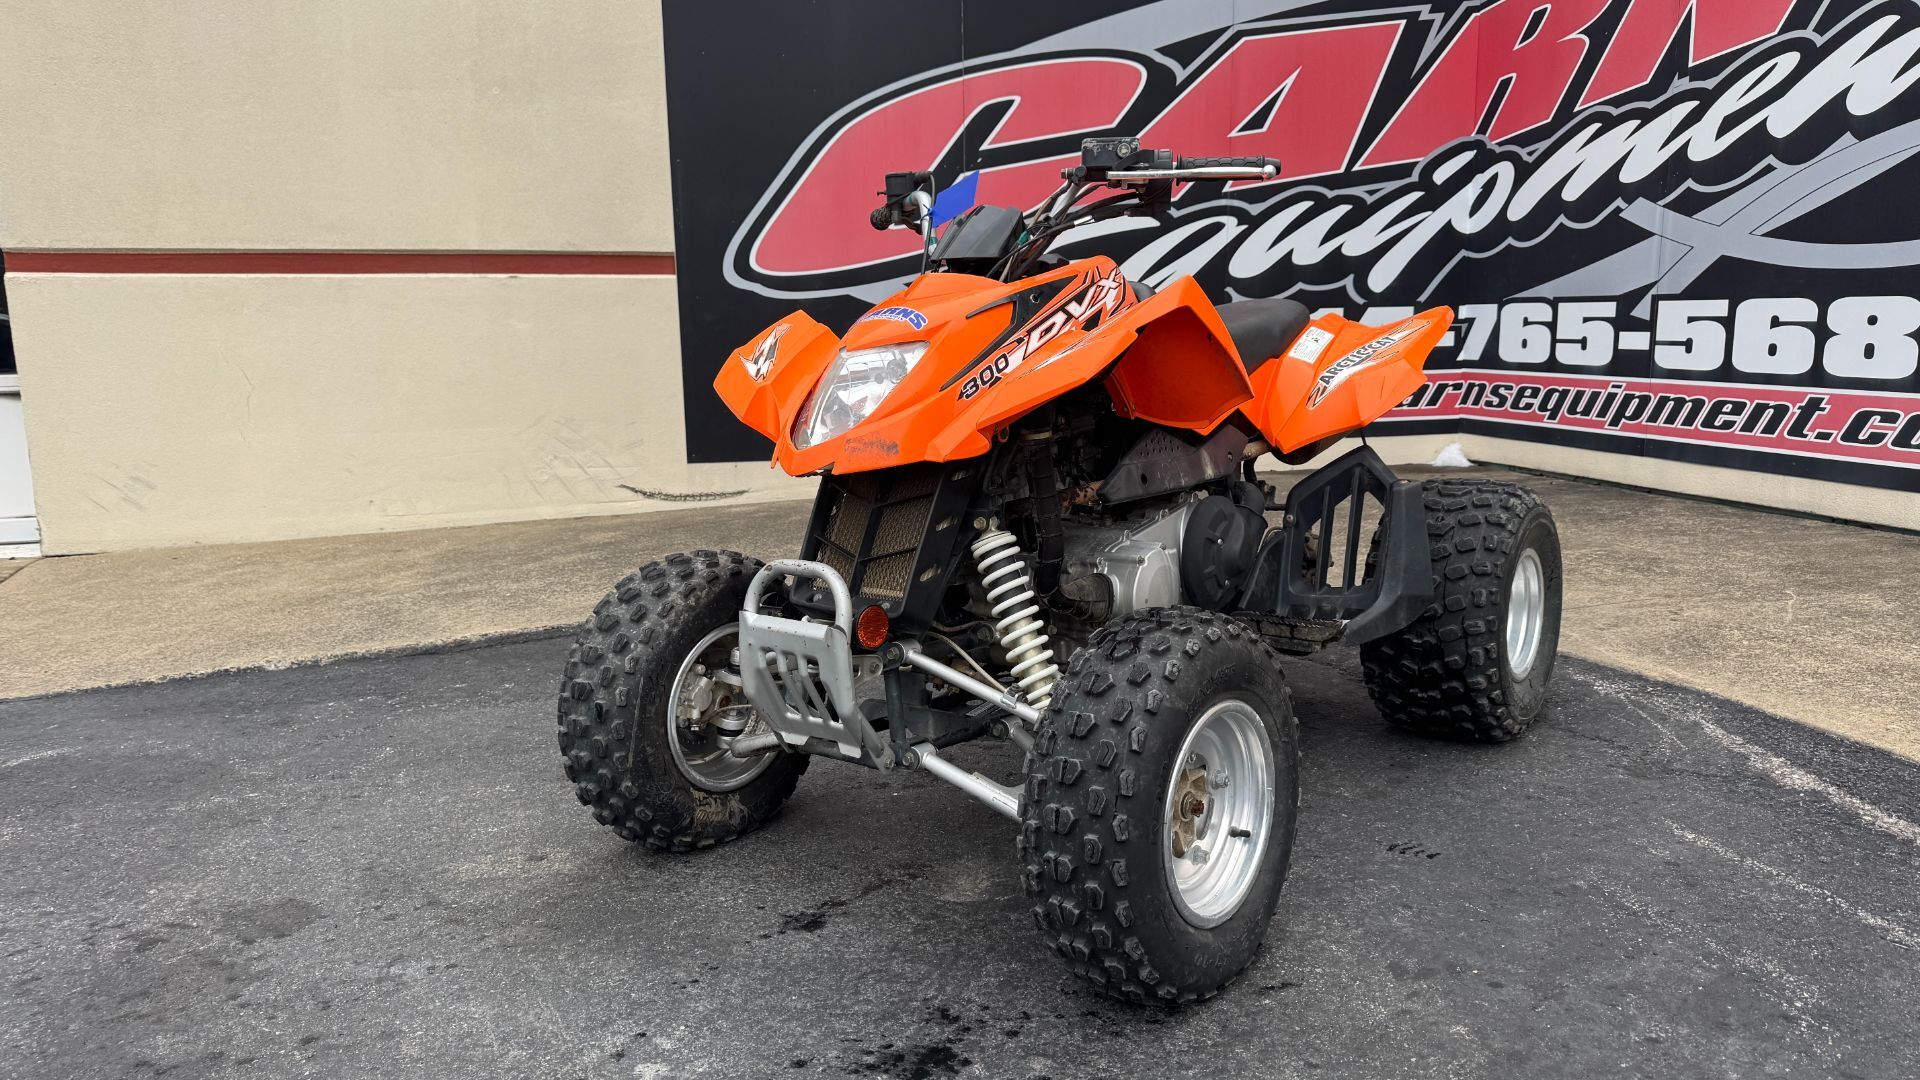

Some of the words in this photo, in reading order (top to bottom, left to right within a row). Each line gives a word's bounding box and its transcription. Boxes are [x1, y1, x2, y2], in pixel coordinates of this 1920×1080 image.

[858, 306, 928, 331] ARNS
[961, 352, 1009, 399] 300
[1022, 266, 1123, 361] DVX
[1310, 296, 1919, 379] -765-568
